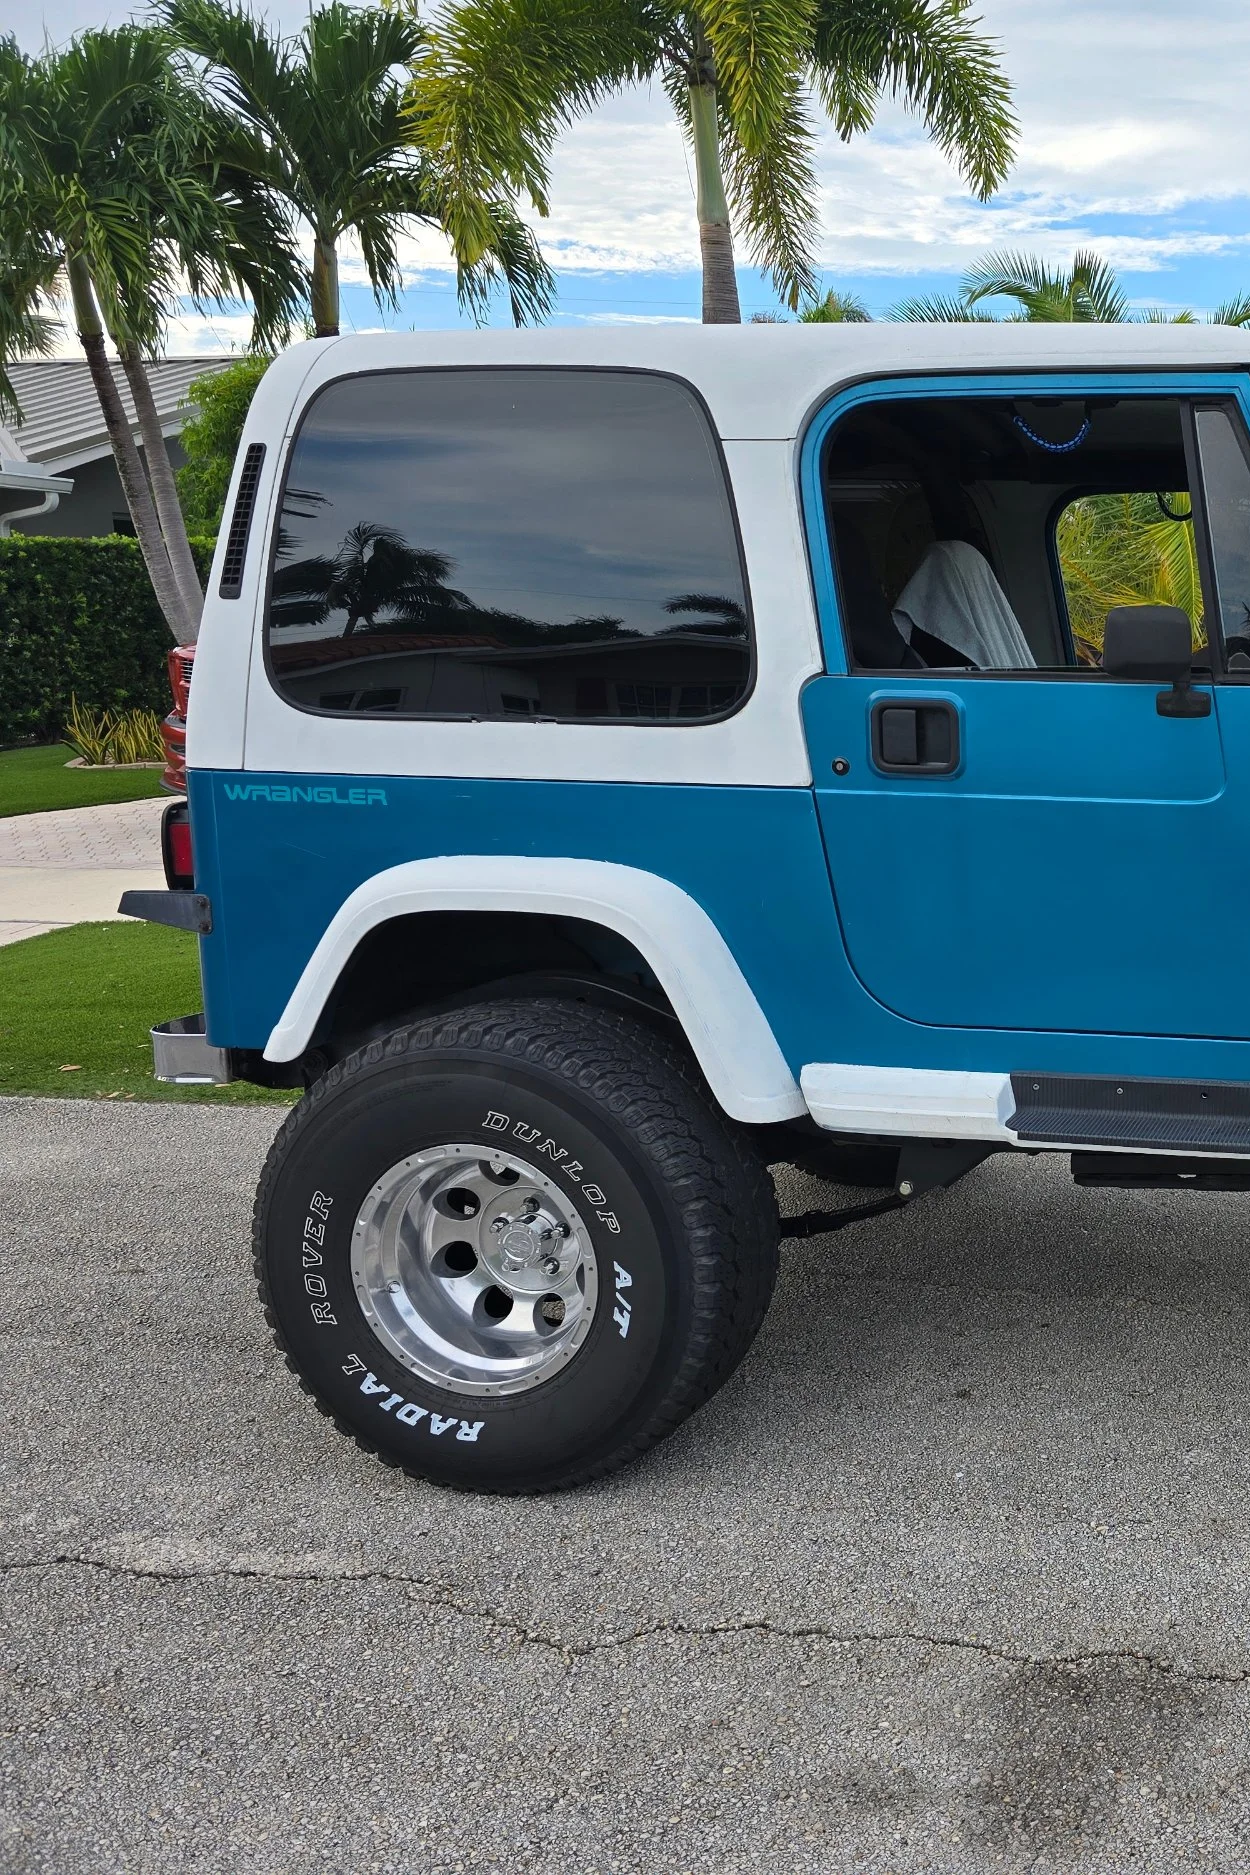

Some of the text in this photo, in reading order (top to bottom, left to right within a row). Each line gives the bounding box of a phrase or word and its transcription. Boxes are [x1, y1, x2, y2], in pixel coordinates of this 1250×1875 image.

[223, 783, 389, 807] WRANGLER
[302, 1190, 486, 1442] RADIAL ROVER
[481, 1110, 633, 1339] DUNLOP A/T
